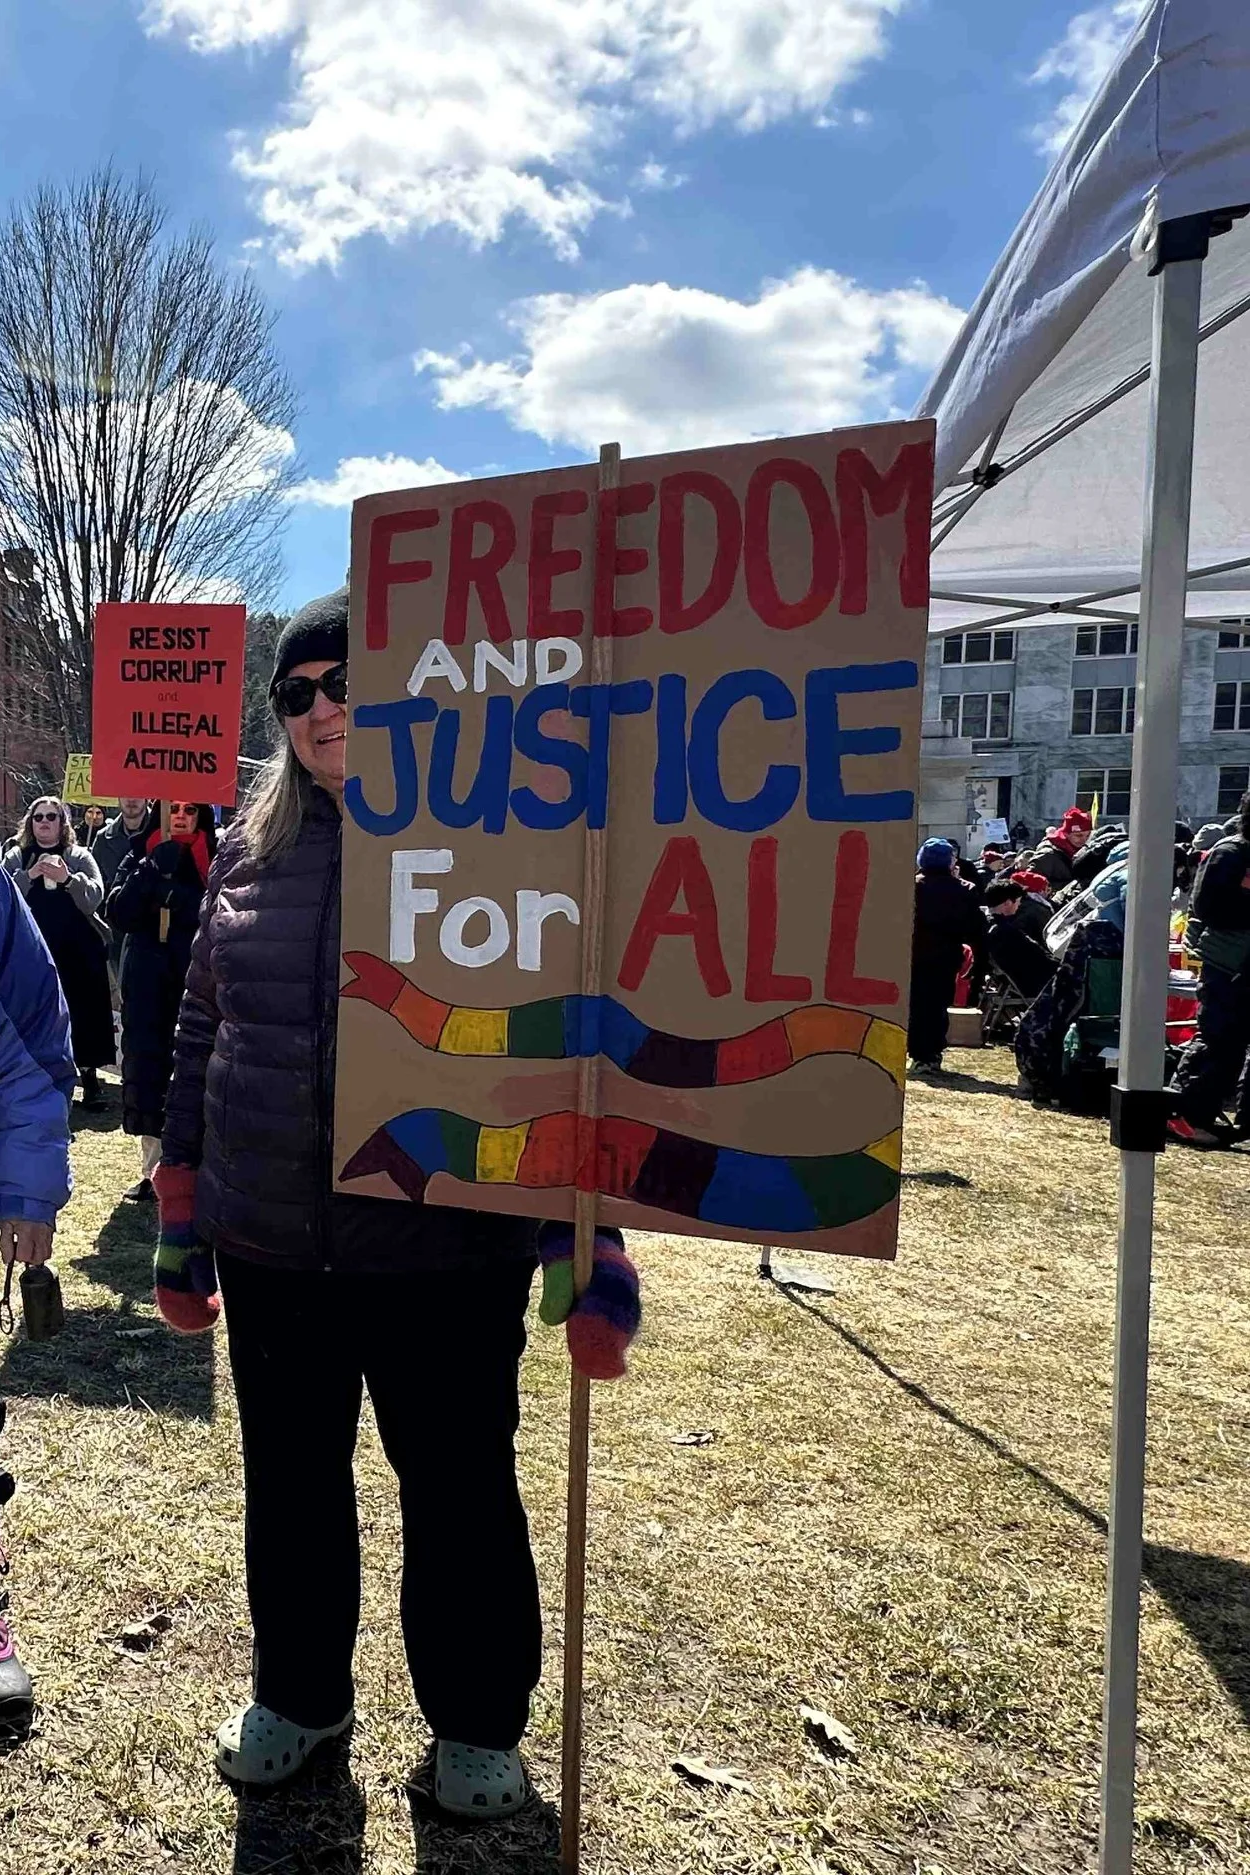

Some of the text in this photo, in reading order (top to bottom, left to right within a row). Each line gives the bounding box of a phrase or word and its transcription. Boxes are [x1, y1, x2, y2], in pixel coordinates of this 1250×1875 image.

[365, 440, 934, 650] FREEDOM
[129, 627, 210, 650] RESIST
[121, 660, 226, 684] CORRUPT
[407, 638, 583, 696] AND
[158, 691, 179, 702] and
[132, 711, 222, 738] ILLEGAL
[124, 748, 217, 774] ACTIONS
[344, 661, 918, 836] JUSTICE
[390, 830, 899, 1005] For ALL
